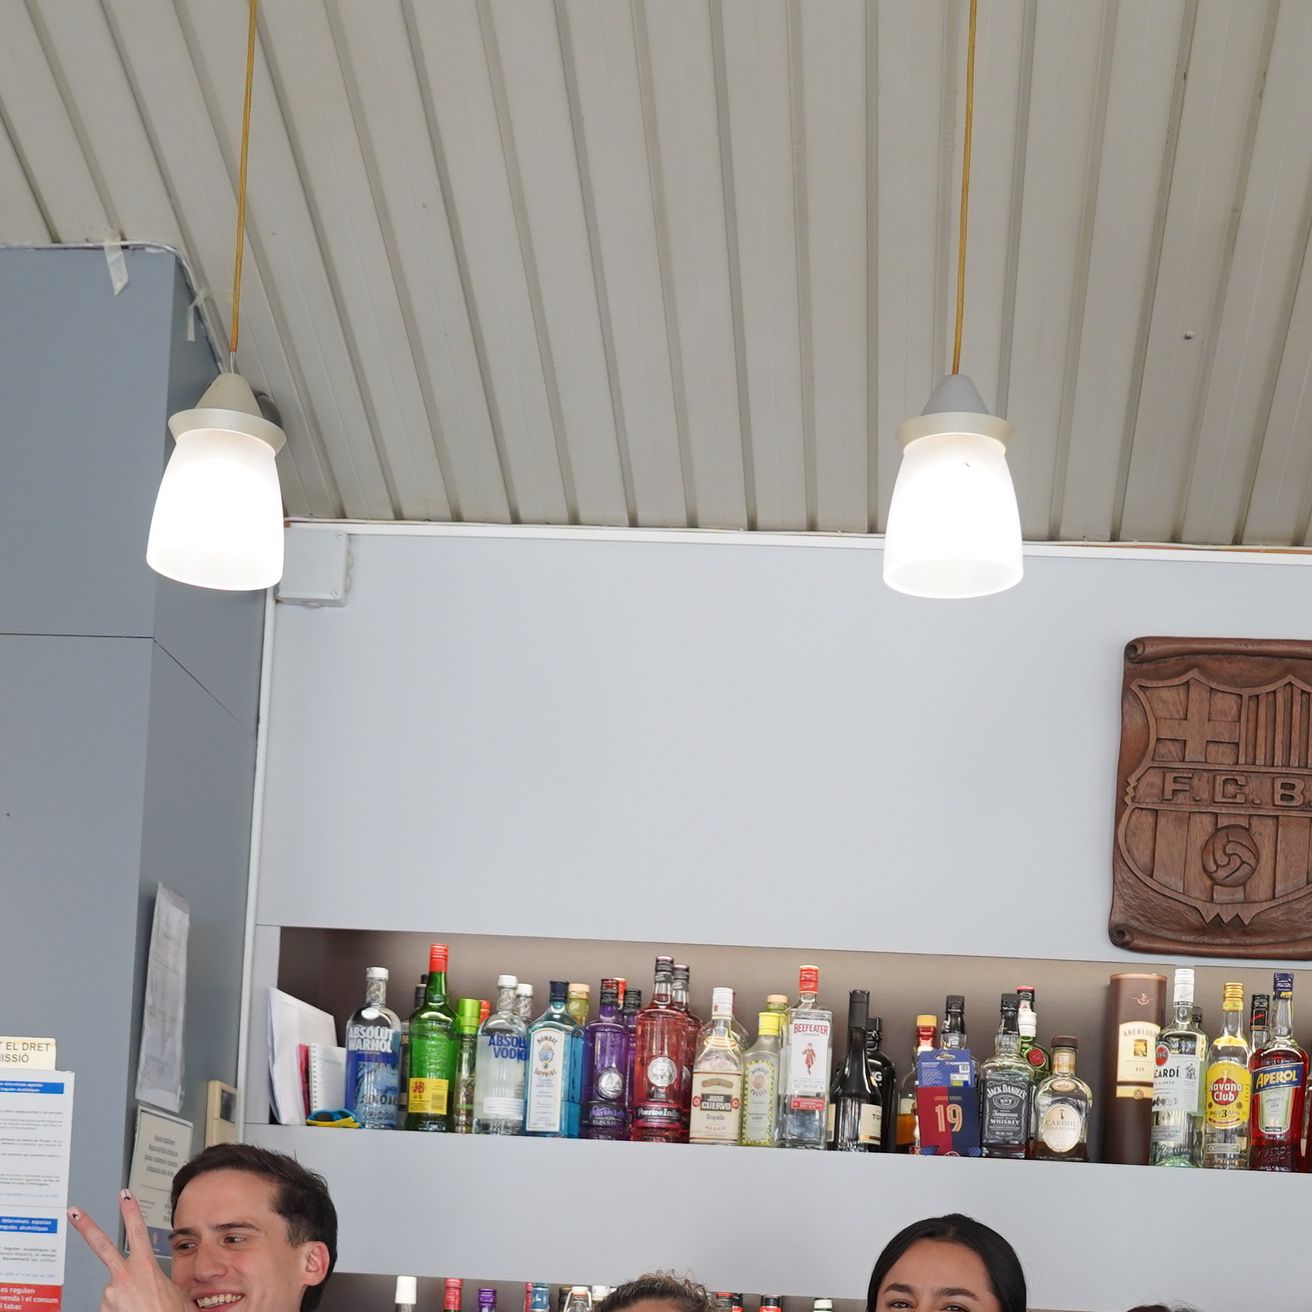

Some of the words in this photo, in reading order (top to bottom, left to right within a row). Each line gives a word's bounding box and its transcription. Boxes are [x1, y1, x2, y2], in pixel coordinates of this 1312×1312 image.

[348, 1025, 393, 1039] ABSOLUT
[793, 1023, 828, 1035] BEEFEATER
[5, 1042, 18, 1051] EL
[22, 1042, 51, 1052] DRET
[1256, 1069, 1298, 1088] APEROL
[1214, 1090, 1235, 1102] Club
[702, 1103, 731, 1111] CUERVO
[935, 1103, 963, 1132] 19
